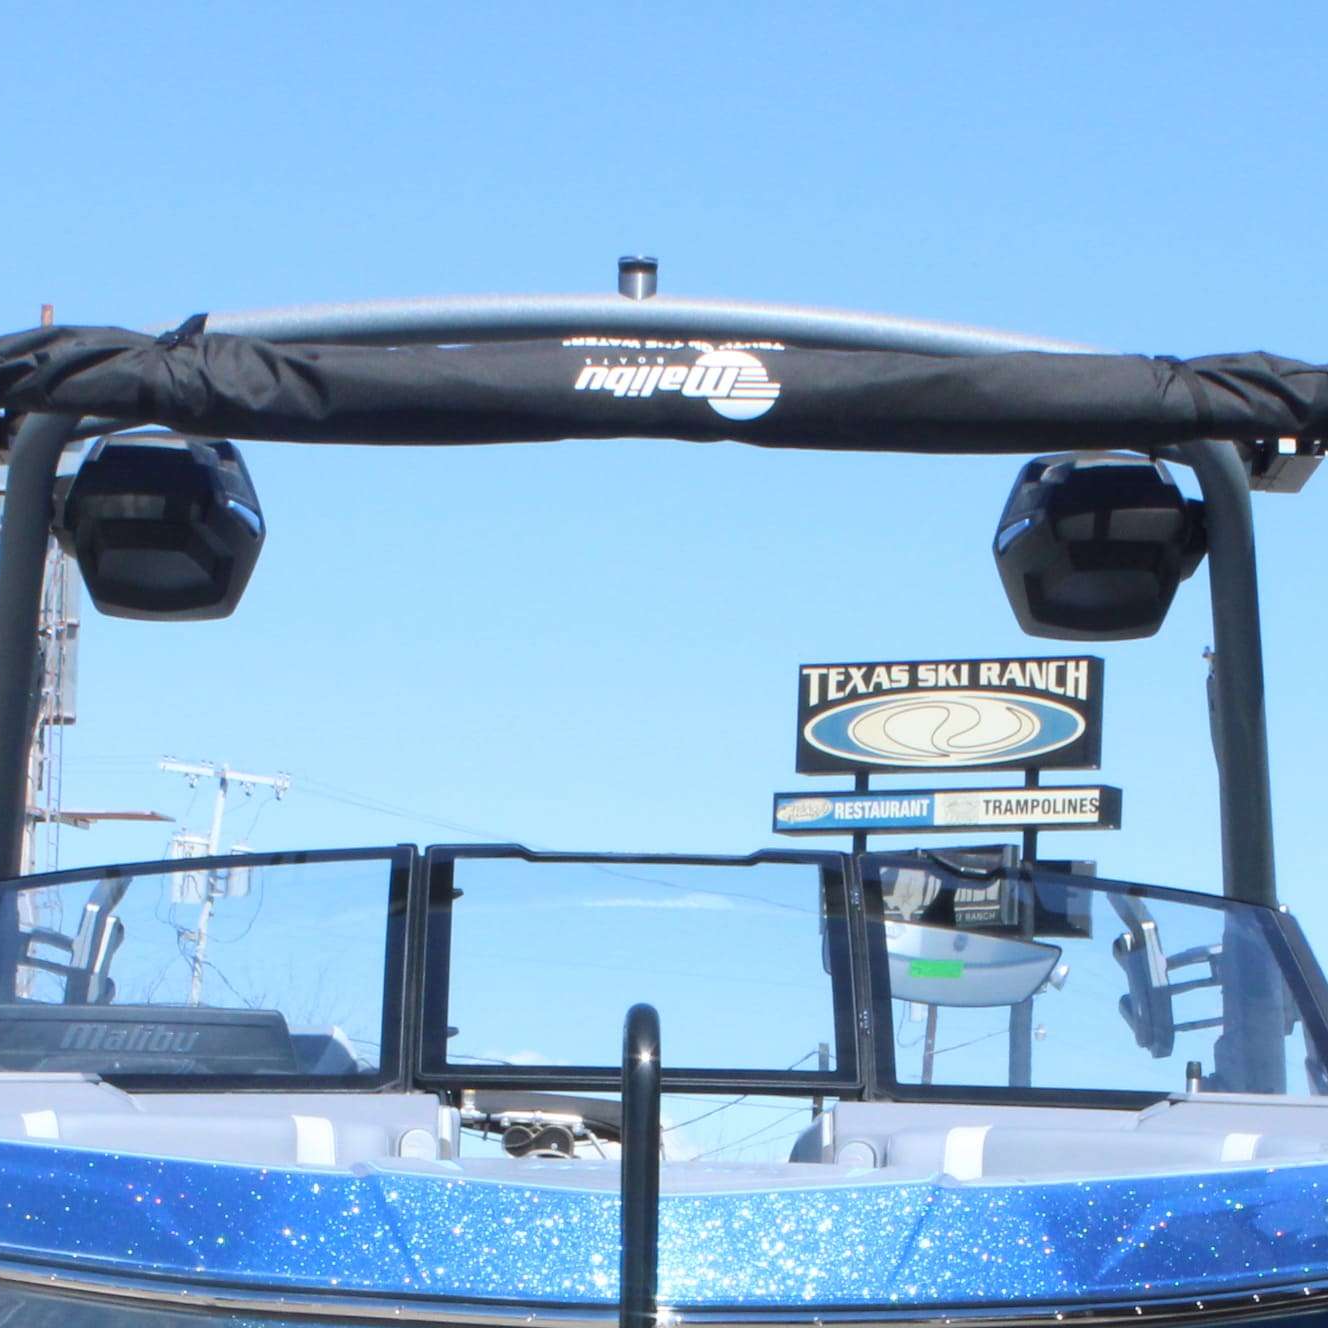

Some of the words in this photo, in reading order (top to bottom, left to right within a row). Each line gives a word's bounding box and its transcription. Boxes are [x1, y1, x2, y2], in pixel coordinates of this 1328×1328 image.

[585, 356, 665, 365] BOATS
[574, 366, 740, 397] Malibu
[802, 665, 909, 707] TEXAS
[917, 663, 970, 689] SKI
[979, 660, 1089, 702] RANCH
[834, 799, 930, 821] RESTAURANT
[982, 796, 1100, 817] TRAMPOLINES
[59, 1024, 201, 1053] Malibu
